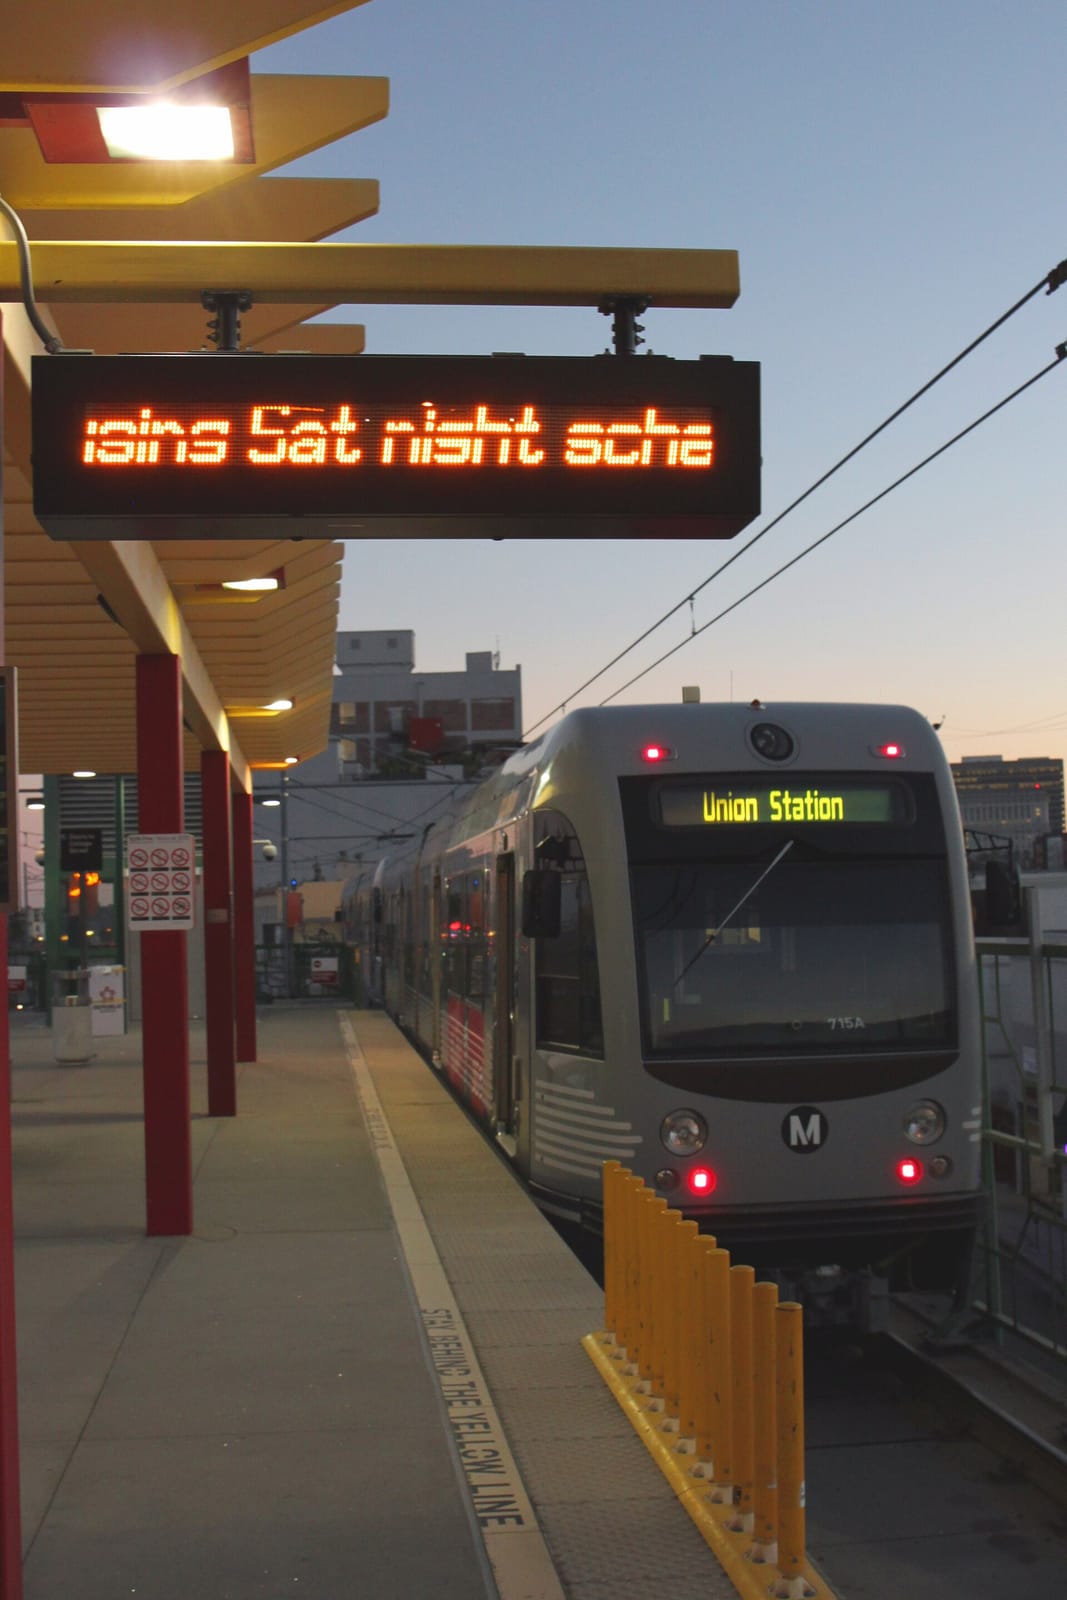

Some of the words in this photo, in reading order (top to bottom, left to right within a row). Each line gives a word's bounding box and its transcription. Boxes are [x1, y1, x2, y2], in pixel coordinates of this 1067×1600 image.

[84, 408, 229, 463] sing
[249, 406, 360, 463] Sat
[383, 406, 543, 465] night
[565, 409, 713, 466] sche
[703, 791, 759, 822] Union
[769, 790, 844, 822] Station
[828, 1016, 865, 1030] 715A
[789, 1114, 821, 1146] M
[422, 1308, 456, 1331] STAY
[431, 1335, 471, 1377] BEHIND
[441, 1381, 482, 1408] THE
[451, 1412, 507, 1475] YELLOW
[471, 1482, 524, 1528] LINE
